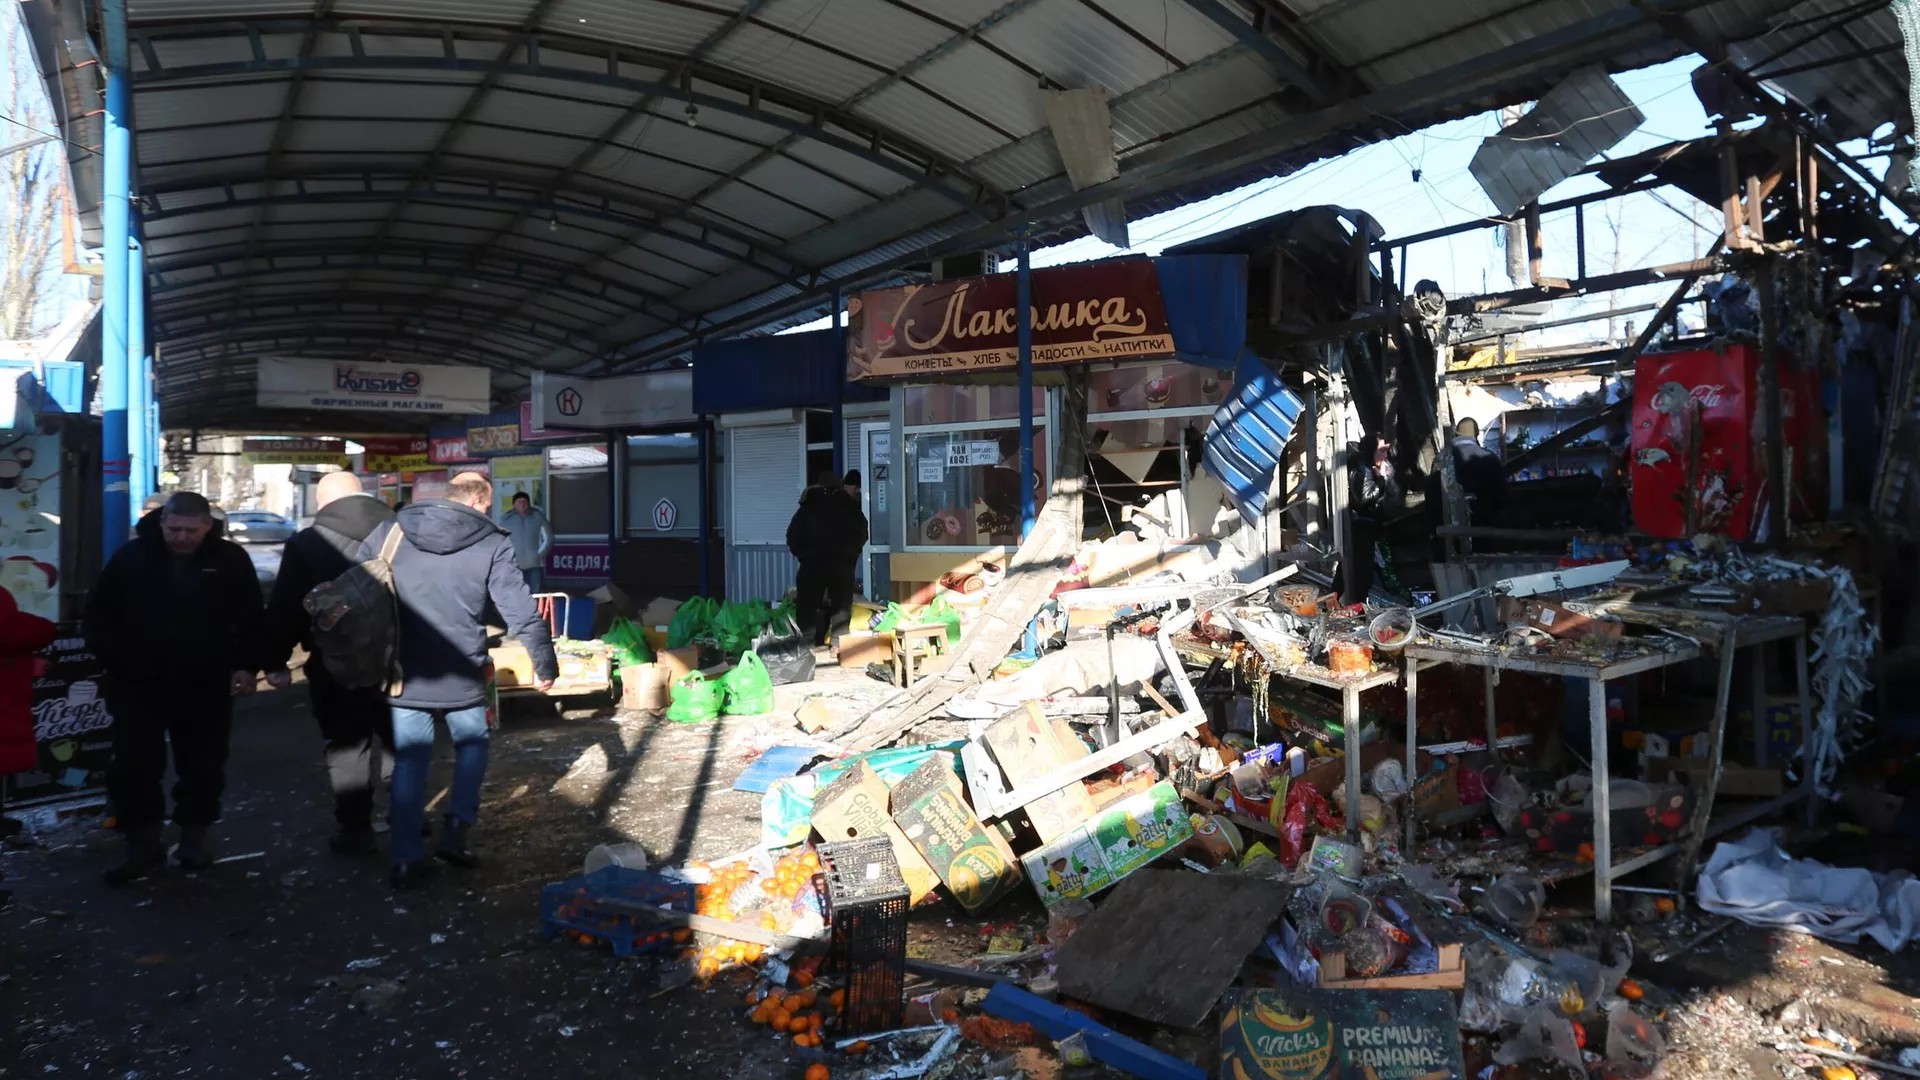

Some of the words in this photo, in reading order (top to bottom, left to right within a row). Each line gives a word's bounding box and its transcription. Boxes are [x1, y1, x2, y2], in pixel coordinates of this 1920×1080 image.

[904, 356, 953, 371] КОНФЕТЫ
[973, 351, 1001, 365] ХЛЕБ
[1031, 345, 1086, 360] ЛАДОСТИ
[1103, 338, 1167, 354] НАПИТКИ
[311, 397, 389, 410] ФИРМЕННЫЙ
[392, 400, 444, 411] МАГАЗИН
[950, 455, 969, 464] КОФЕ
[951, 444, 966, 455] ЧАЙ
[553, 555, 573, 569] ВСЕ
[575, 555, 601, 571] ДЛЯ
[853, 793, 889, 829] Global
[930, 794, 973, 842] BANANAS
[920, 805, 963, 852] PREMIUM
[1257, 1031, 1320, 1056] Vicky
[1342, 1025, 1443, 1047] PREMIUM
[1262, 1049, 1329, 1070] BANANAS
[1348, 1047, 1449, 1068] BANANAS
